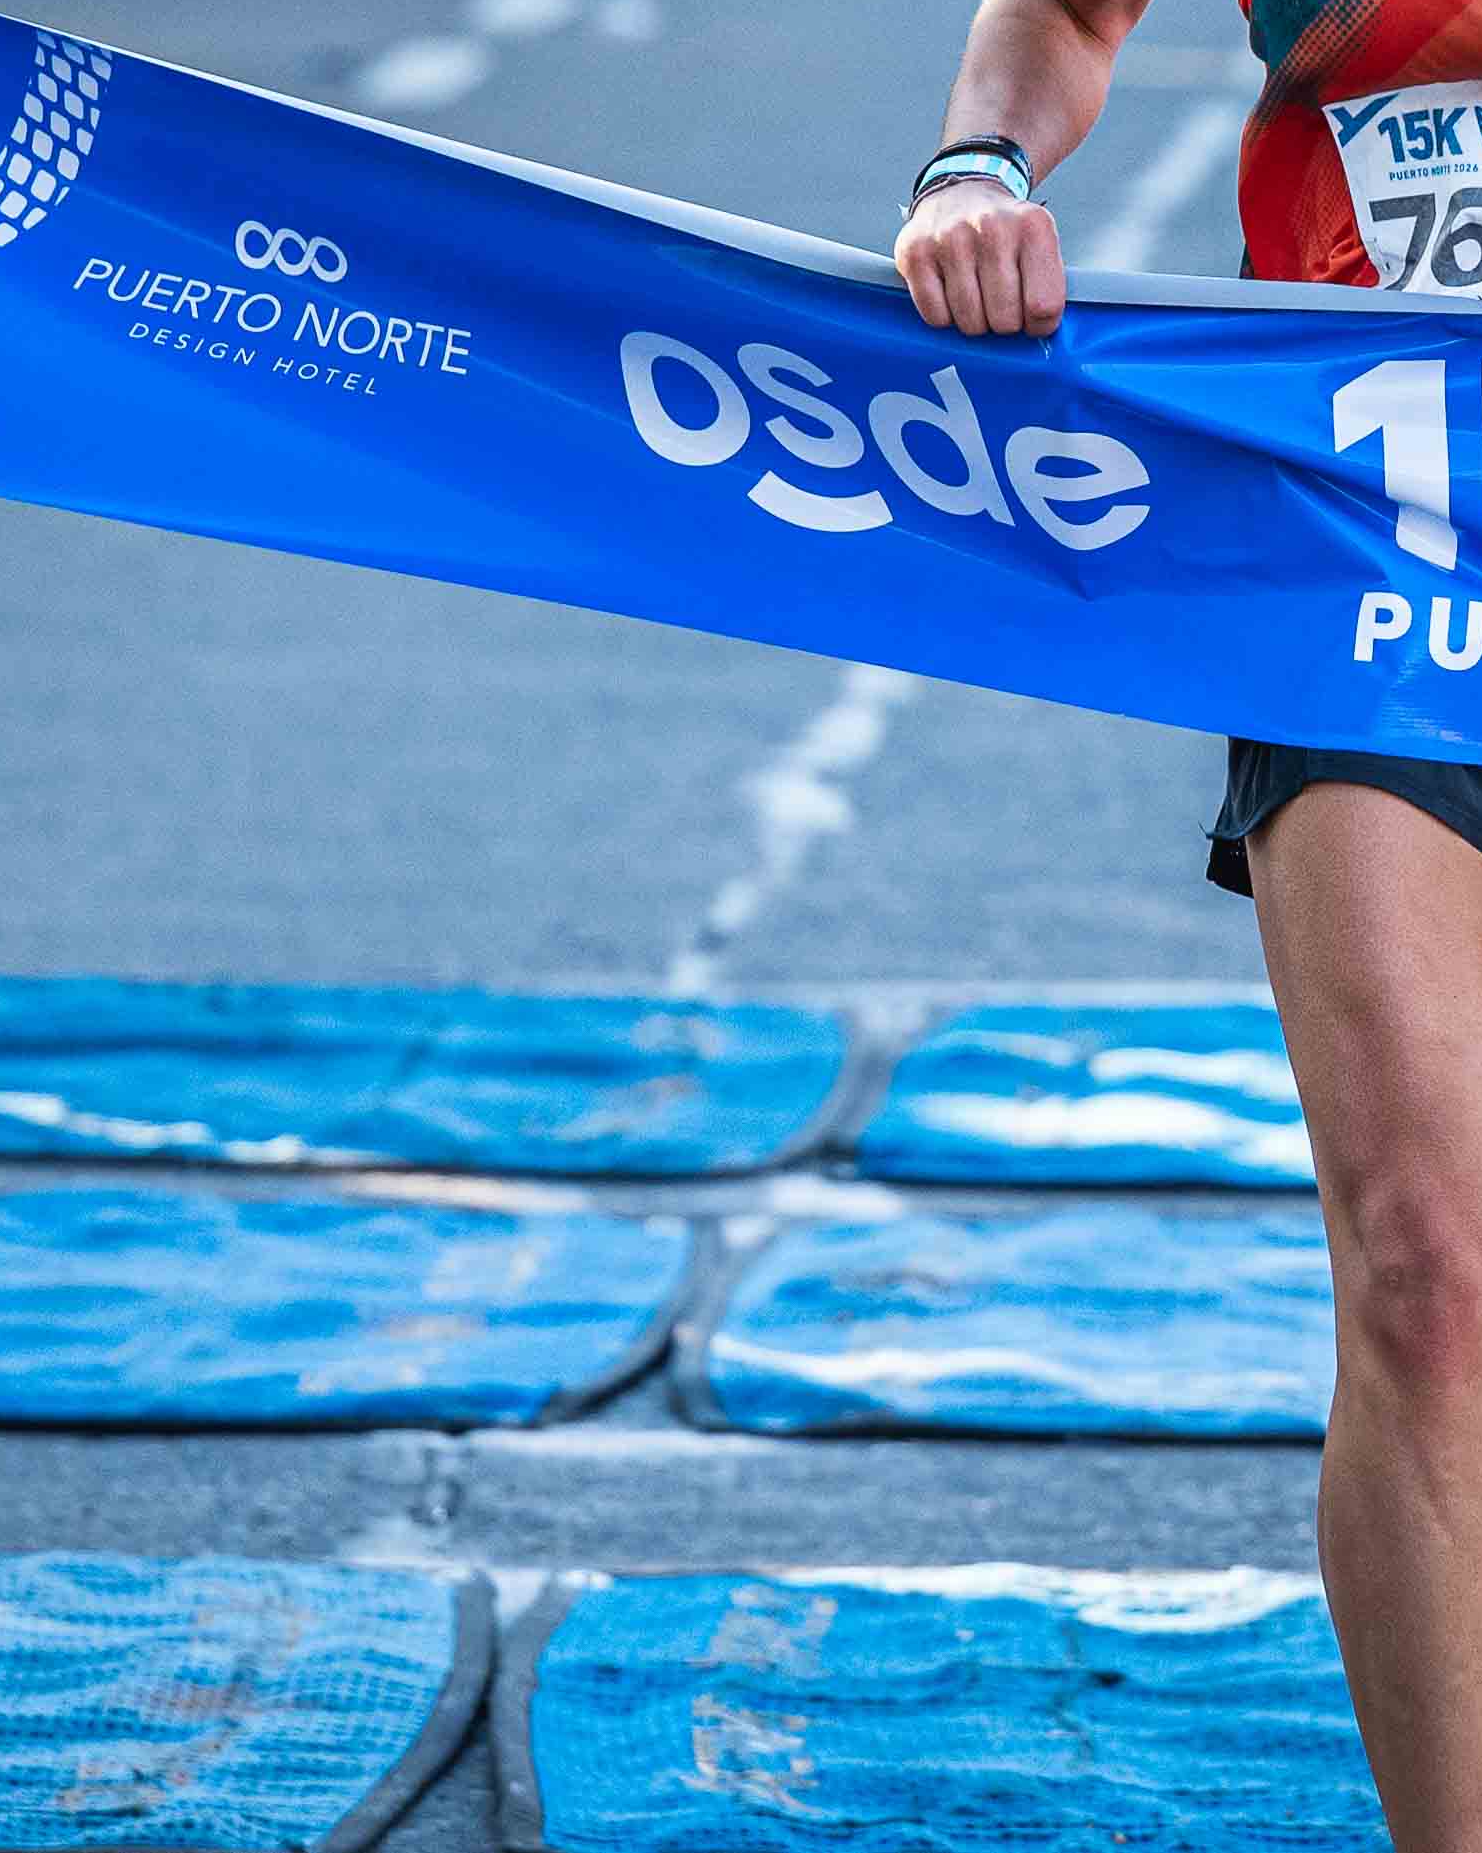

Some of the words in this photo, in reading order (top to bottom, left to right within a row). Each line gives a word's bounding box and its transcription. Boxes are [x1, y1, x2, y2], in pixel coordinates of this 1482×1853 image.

[1377, 107, 1468, 164] 15K
[1389, 167, 1429, 181] PUERTO
[1453, 163, 1479, 173] 2026
[72, 257, 283, 333] PUERTO
[292, 302, 472, 375] NORTE
[127, 322, 256, 366] DESIGN
[272, 356, 377, 395] HOTEL
[620, 331, 1151, 551] osde
